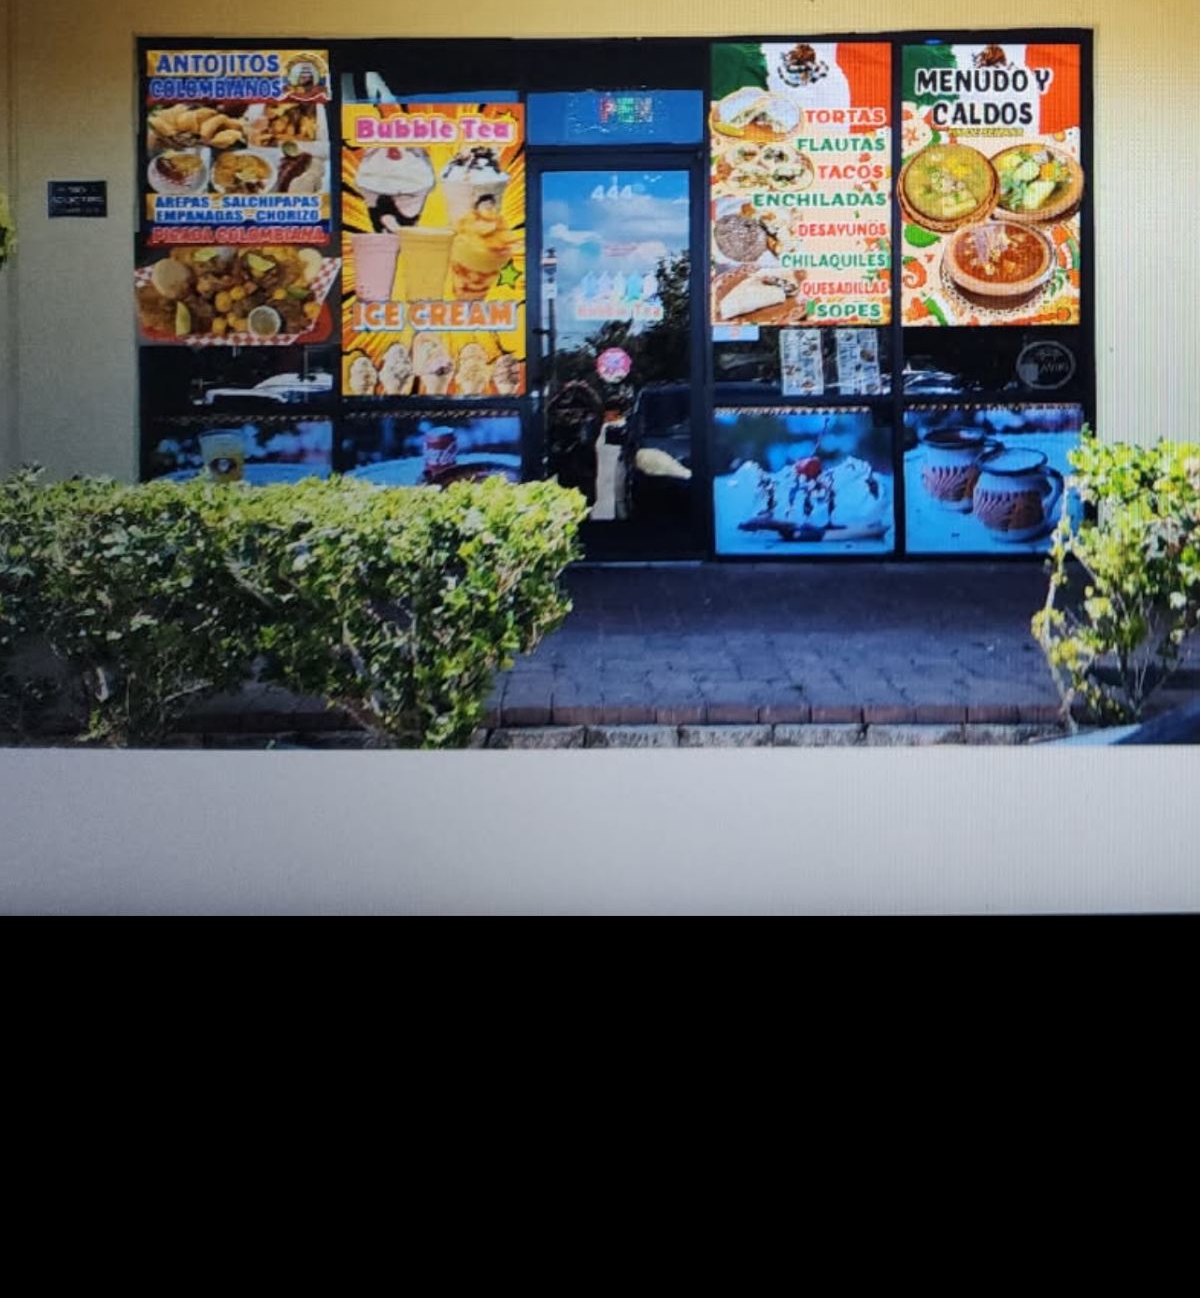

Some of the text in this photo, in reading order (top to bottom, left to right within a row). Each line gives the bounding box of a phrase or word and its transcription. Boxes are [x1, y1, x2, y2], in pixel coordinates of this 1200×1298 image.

[156, 54, 280, 77] ANTOJITOS
[916, 69, 1051, 93] MENUDO Y
[151, 78, 282, 99] COLOMBIANOS
[805, 110, 886, 124] TORTAS
[932, 102, 1033, 125] CALDOS
[356, 118, 512, 139] Bubble Tea
[797, 138, 886, 152] FLAUTAS
[817, 165, 884, 179] TACOS
[591, 184, 632, 200] 444
[156, 196, 210, 208] AREPAS
[222, 196, 319, 208] SALCHIPAPAS
[753, 193, 887, 207] ENCHILADAS
[156, 210, 244, 221] EMPANADAS
[256, 210, 319, 221] CHORIZO
[798, 223, 887, 236] DESAYUNOS
[781, 254, 886, 270] CHILAQUILES
[803, 282, 888, 296] QUESADILLAS
[353, 302, 515, 327] ICE CREAM
[816, 304, 881, 317] SOPES
